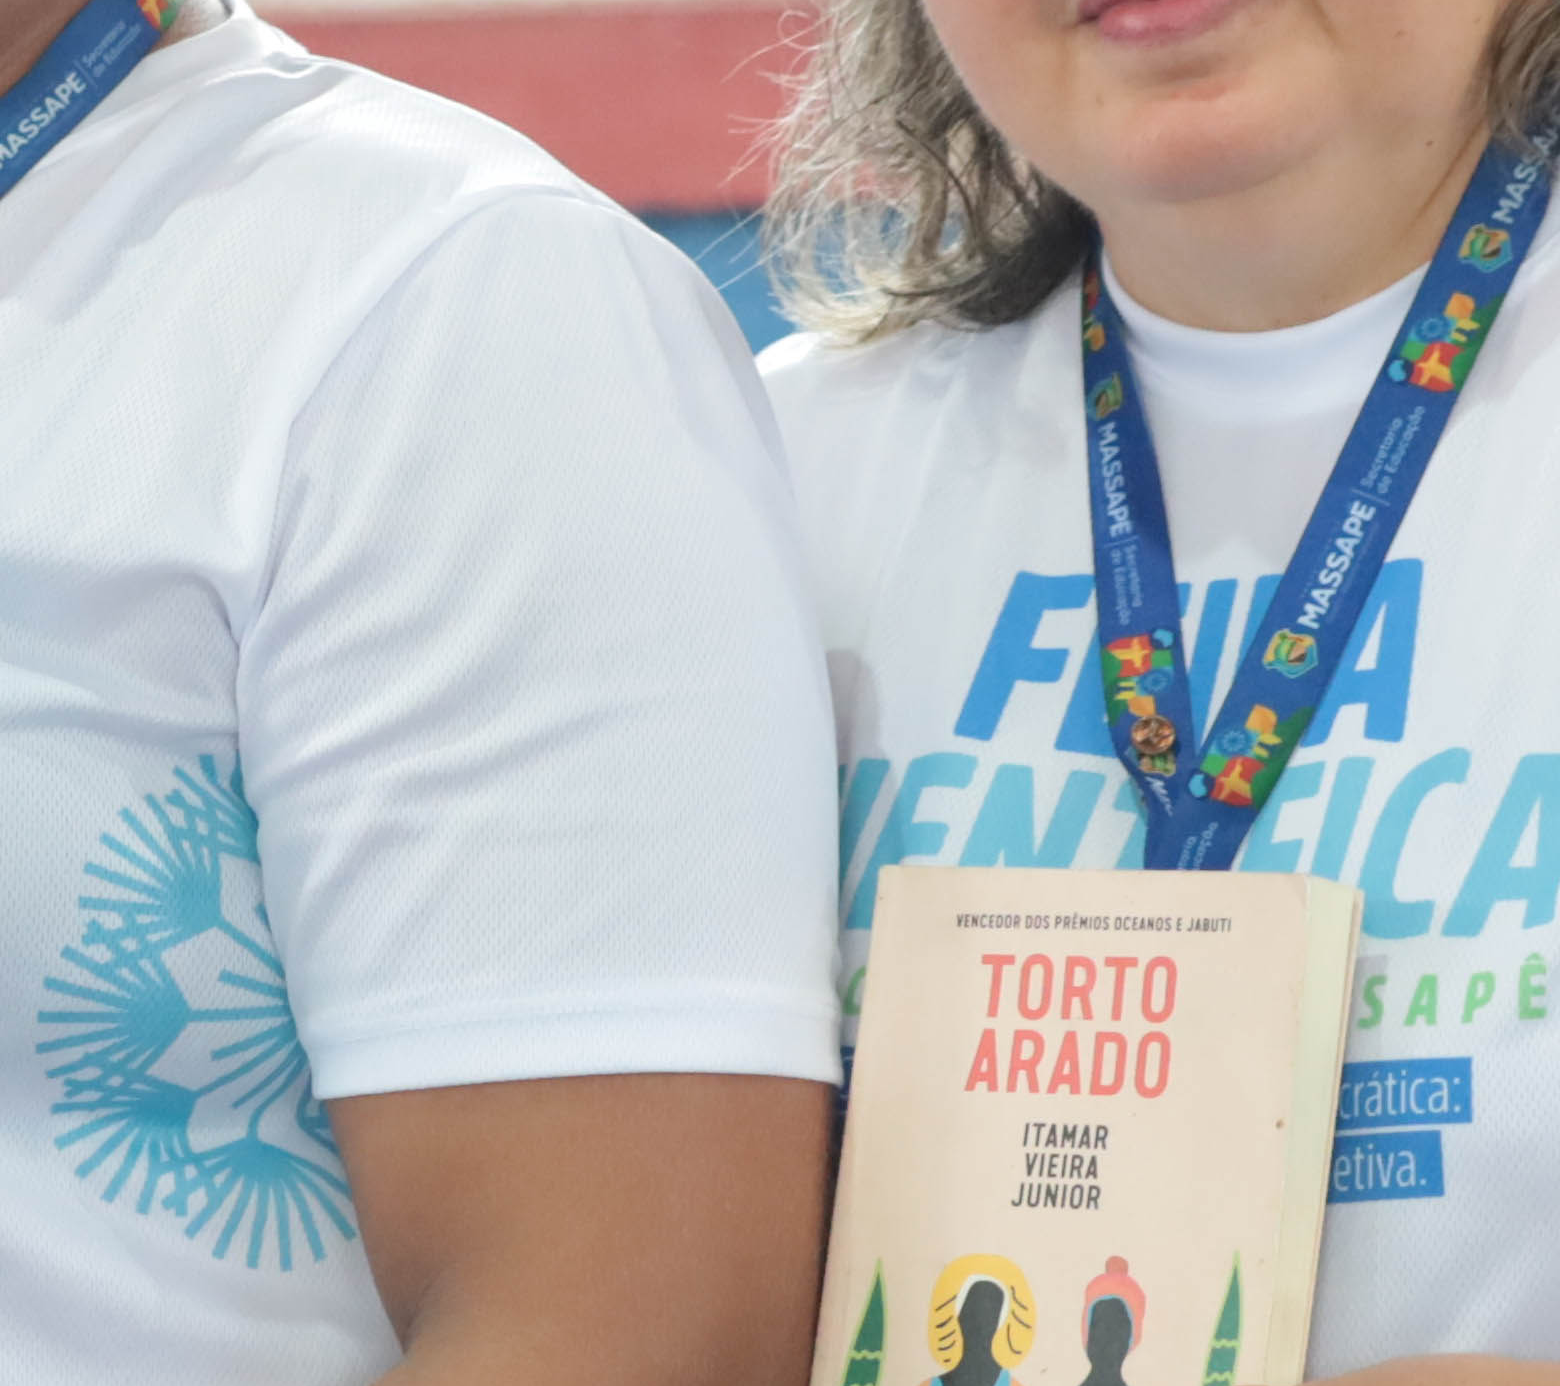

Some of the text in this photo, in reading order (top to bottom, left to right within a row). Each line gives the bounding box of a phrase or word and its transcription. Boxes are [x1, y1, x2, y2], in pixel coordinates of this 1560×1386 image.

[953, 557, 1424, 760] FIA
[955, 912, 1233, 933] VENCEDOR DOS PRÊMIOS OCEANOS E JABUTI
[980, 952, 1179, 1024] TORTO
[1357, 951, 1549, 1030] SAPÊ
[963, 1027, 1172, 1099] ARADO
[1338, 1068, 1462, 1120] crática:
[1022, 1121, 1110, 1151] ITAMAR
[1024, 1151, 1099, 1180] VIEIRA
[1333, 1143, 1428, 1193] etiva.
[1010, 1181, 1102, 1210] JUNIOR
